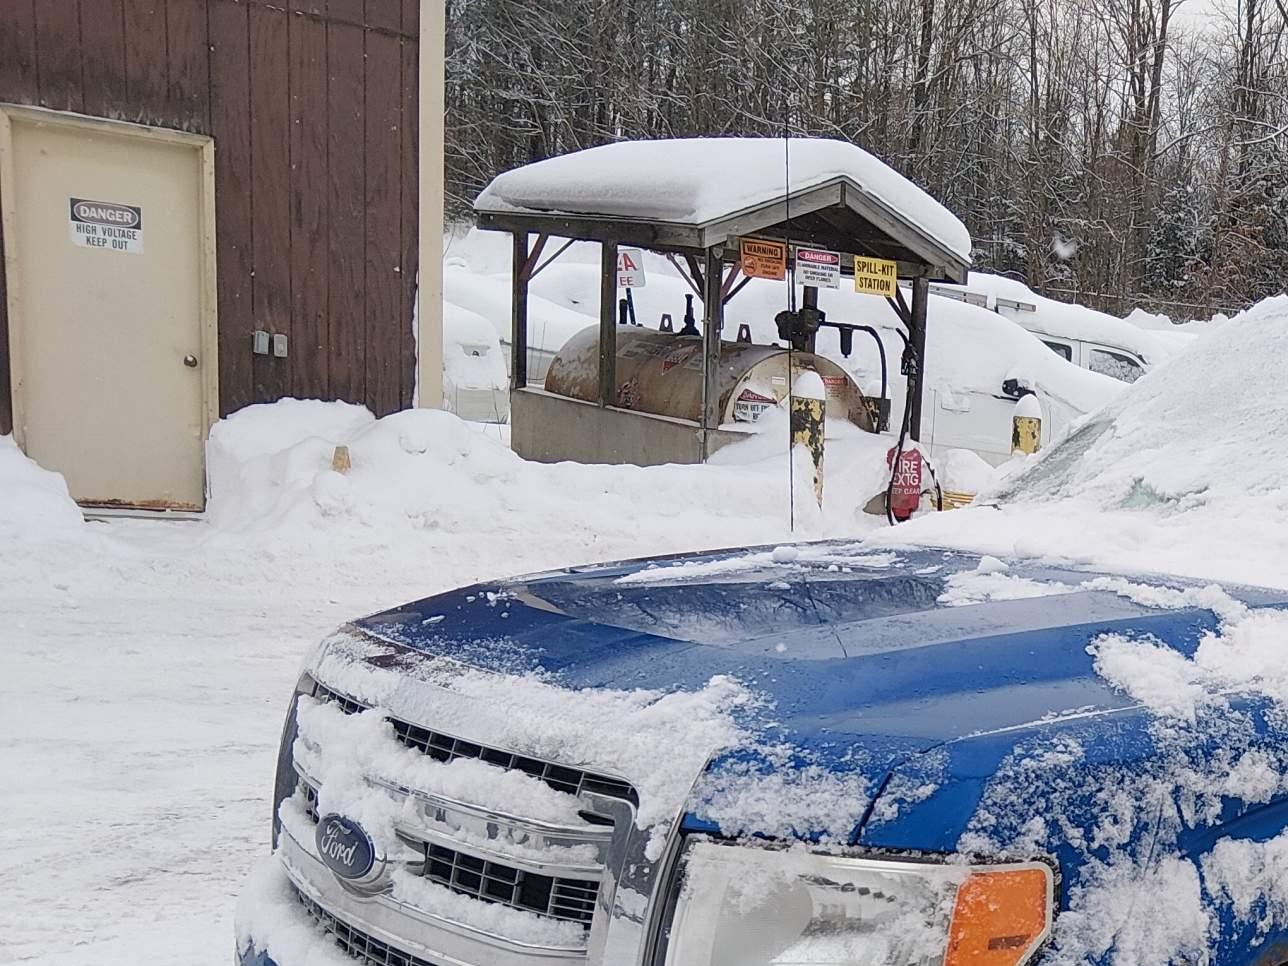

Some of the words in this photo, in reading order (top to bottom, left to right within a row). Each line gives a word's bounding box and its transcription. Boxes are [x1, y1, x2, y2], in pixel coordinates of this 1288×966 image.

[80, 206, 132, 223] DANGER
[76, 223, 97, 235] HIGH
[102, 227, 137, 240] VOLTAGE
[86, 236, 107, 247] KEEP
[112, 239, 128, 250] OUT
[746, 244, 779, 257] WARNING
[804, 252, 832, 262] DANGER
[857, 261, 894, 276] SPILL-KIT
[859, 277, 891, 291] STATION
[898, 460, 918, 473] IRE
[321, 820, 358, 866] Ford
